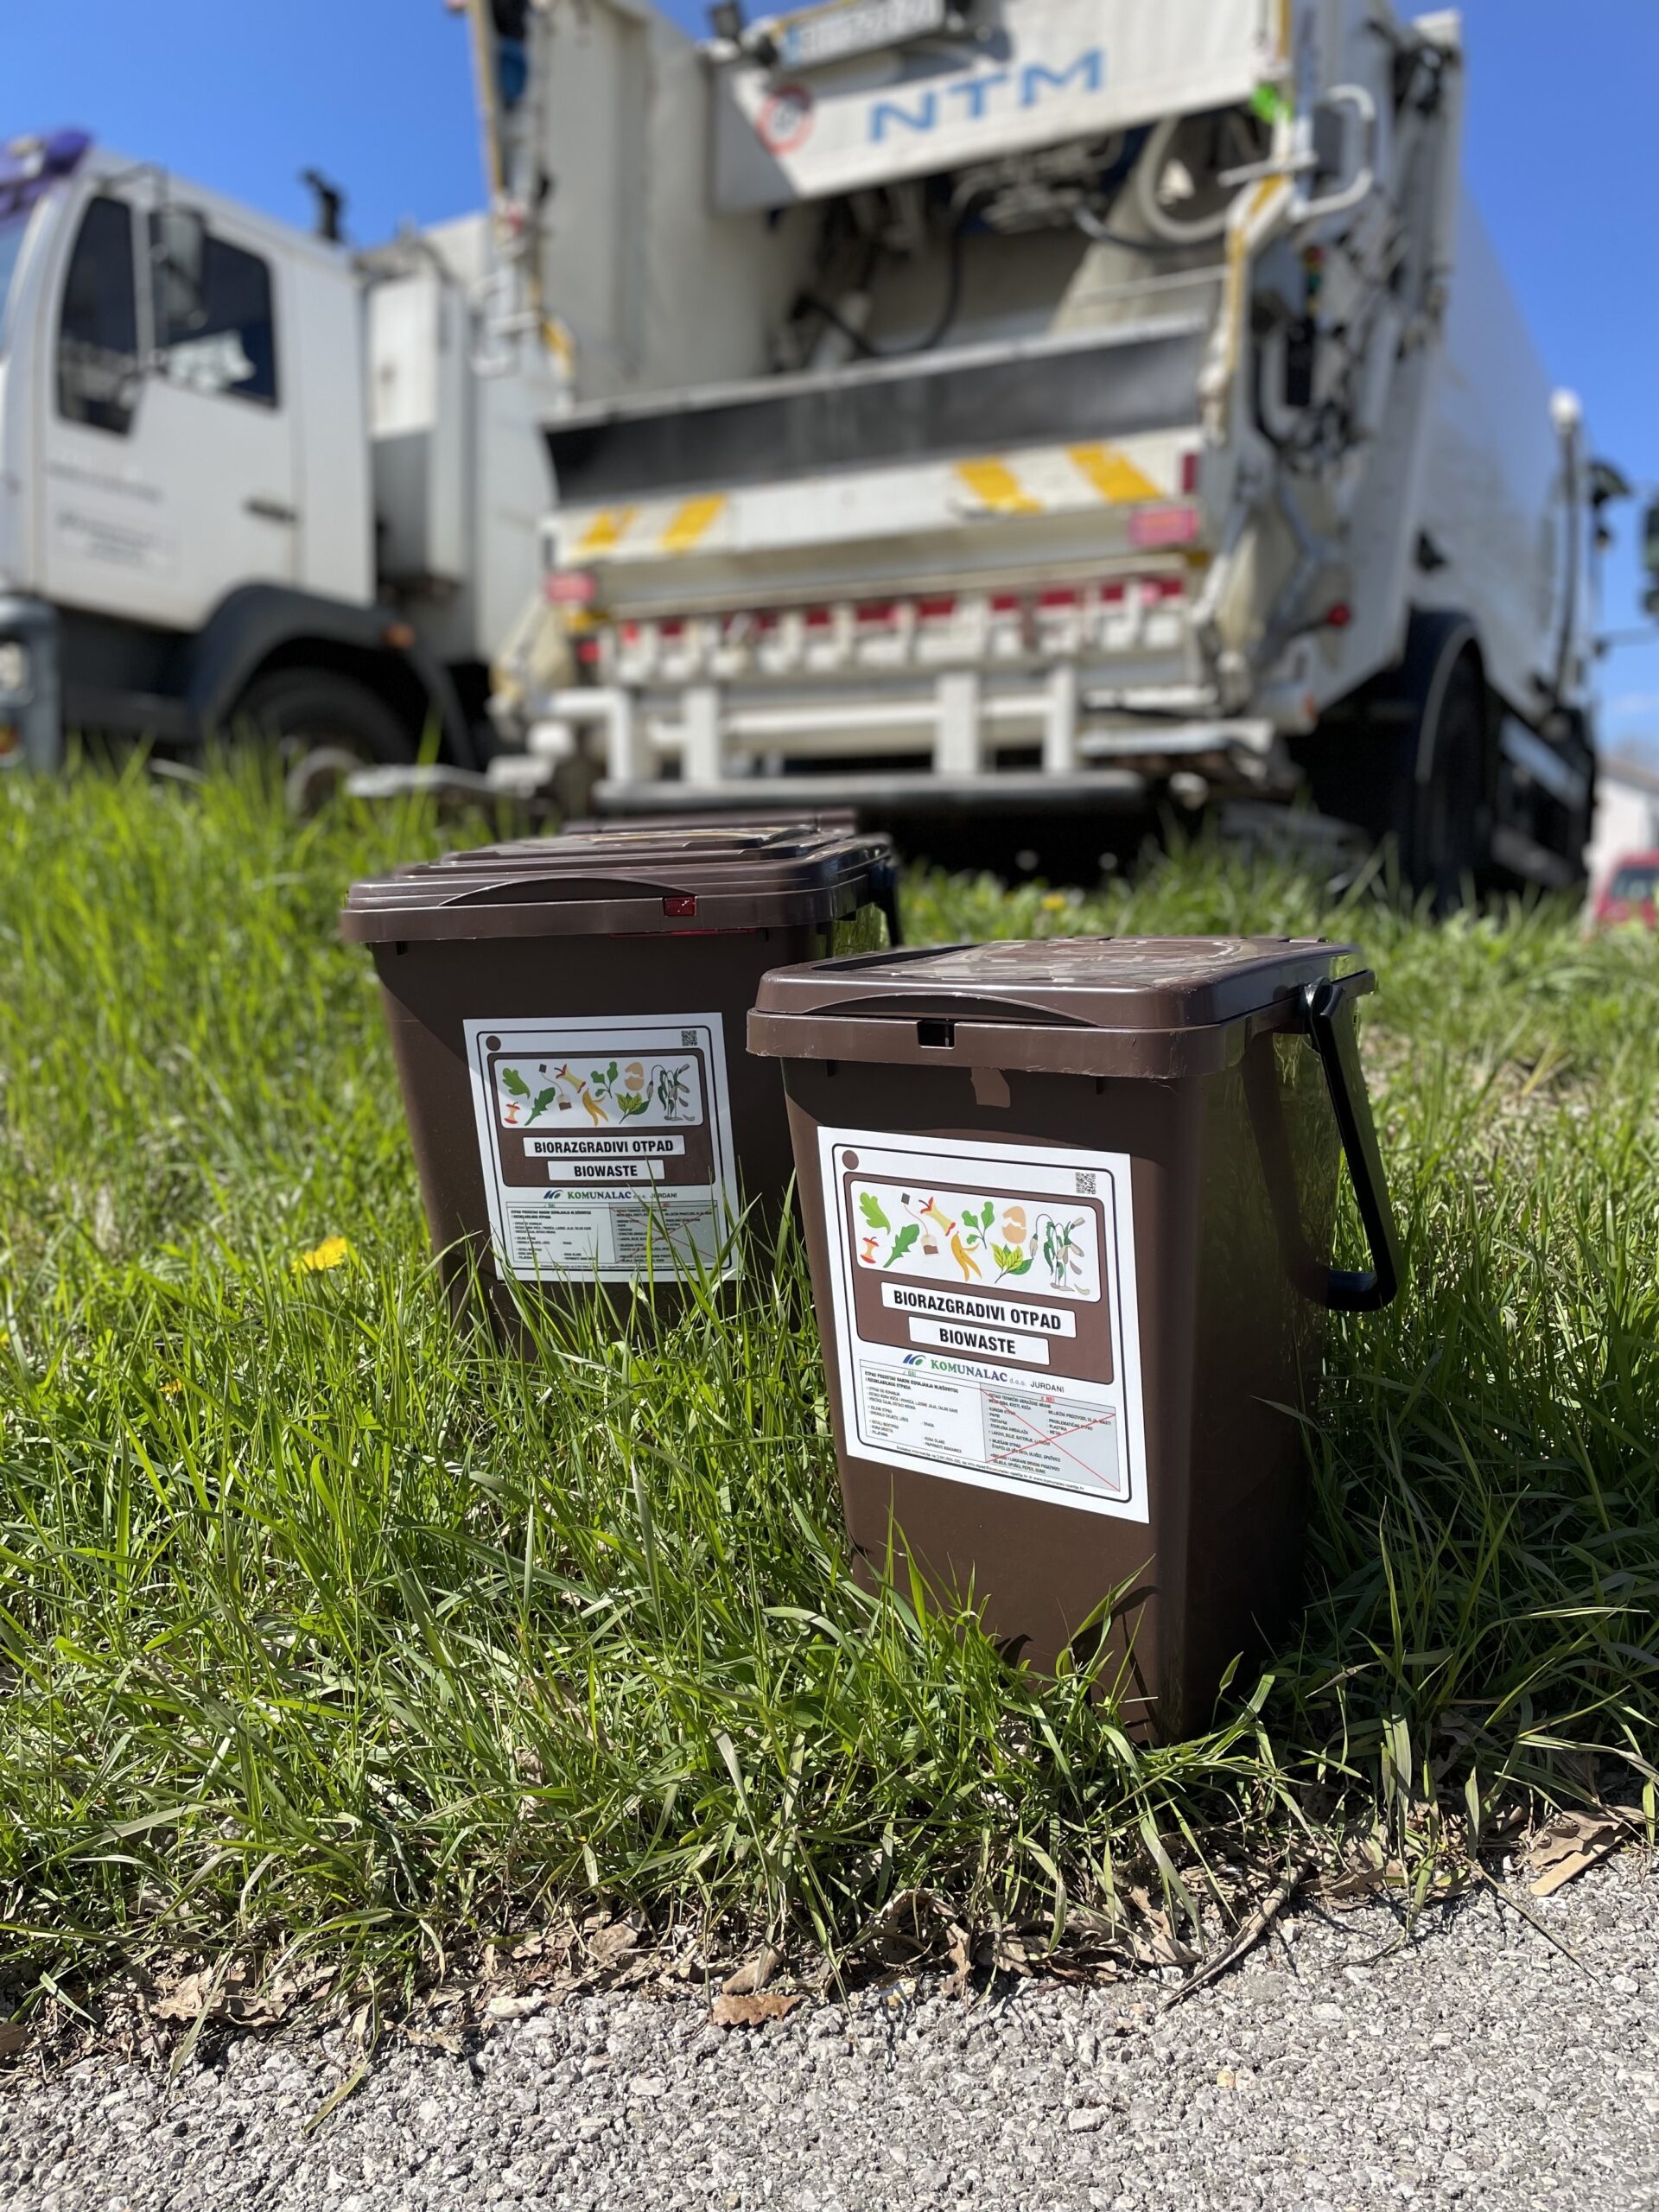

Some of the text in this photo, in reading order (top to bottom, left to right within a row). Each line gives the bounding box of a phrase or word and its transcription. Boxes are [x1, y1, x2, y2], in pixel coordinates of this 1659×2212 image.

[868, 47, 1105, 143] NTM
[534, 1140, 674, 1154] BIORAZGRADIVI OTPAD
[574, 1165, 638, 1177] BIOWASTE
[567, 1191, 632, 1200] KOMUNALAC
[893, 1289, 1062, 1331] BIORAZGRADIVI OTPAD
[939, 1327, 1016, 1355] BIOWASTE
[930, 1359, 1007, 1382] KOMUNALAC
[1030, 1381, 1065, 1394] JURDANI
